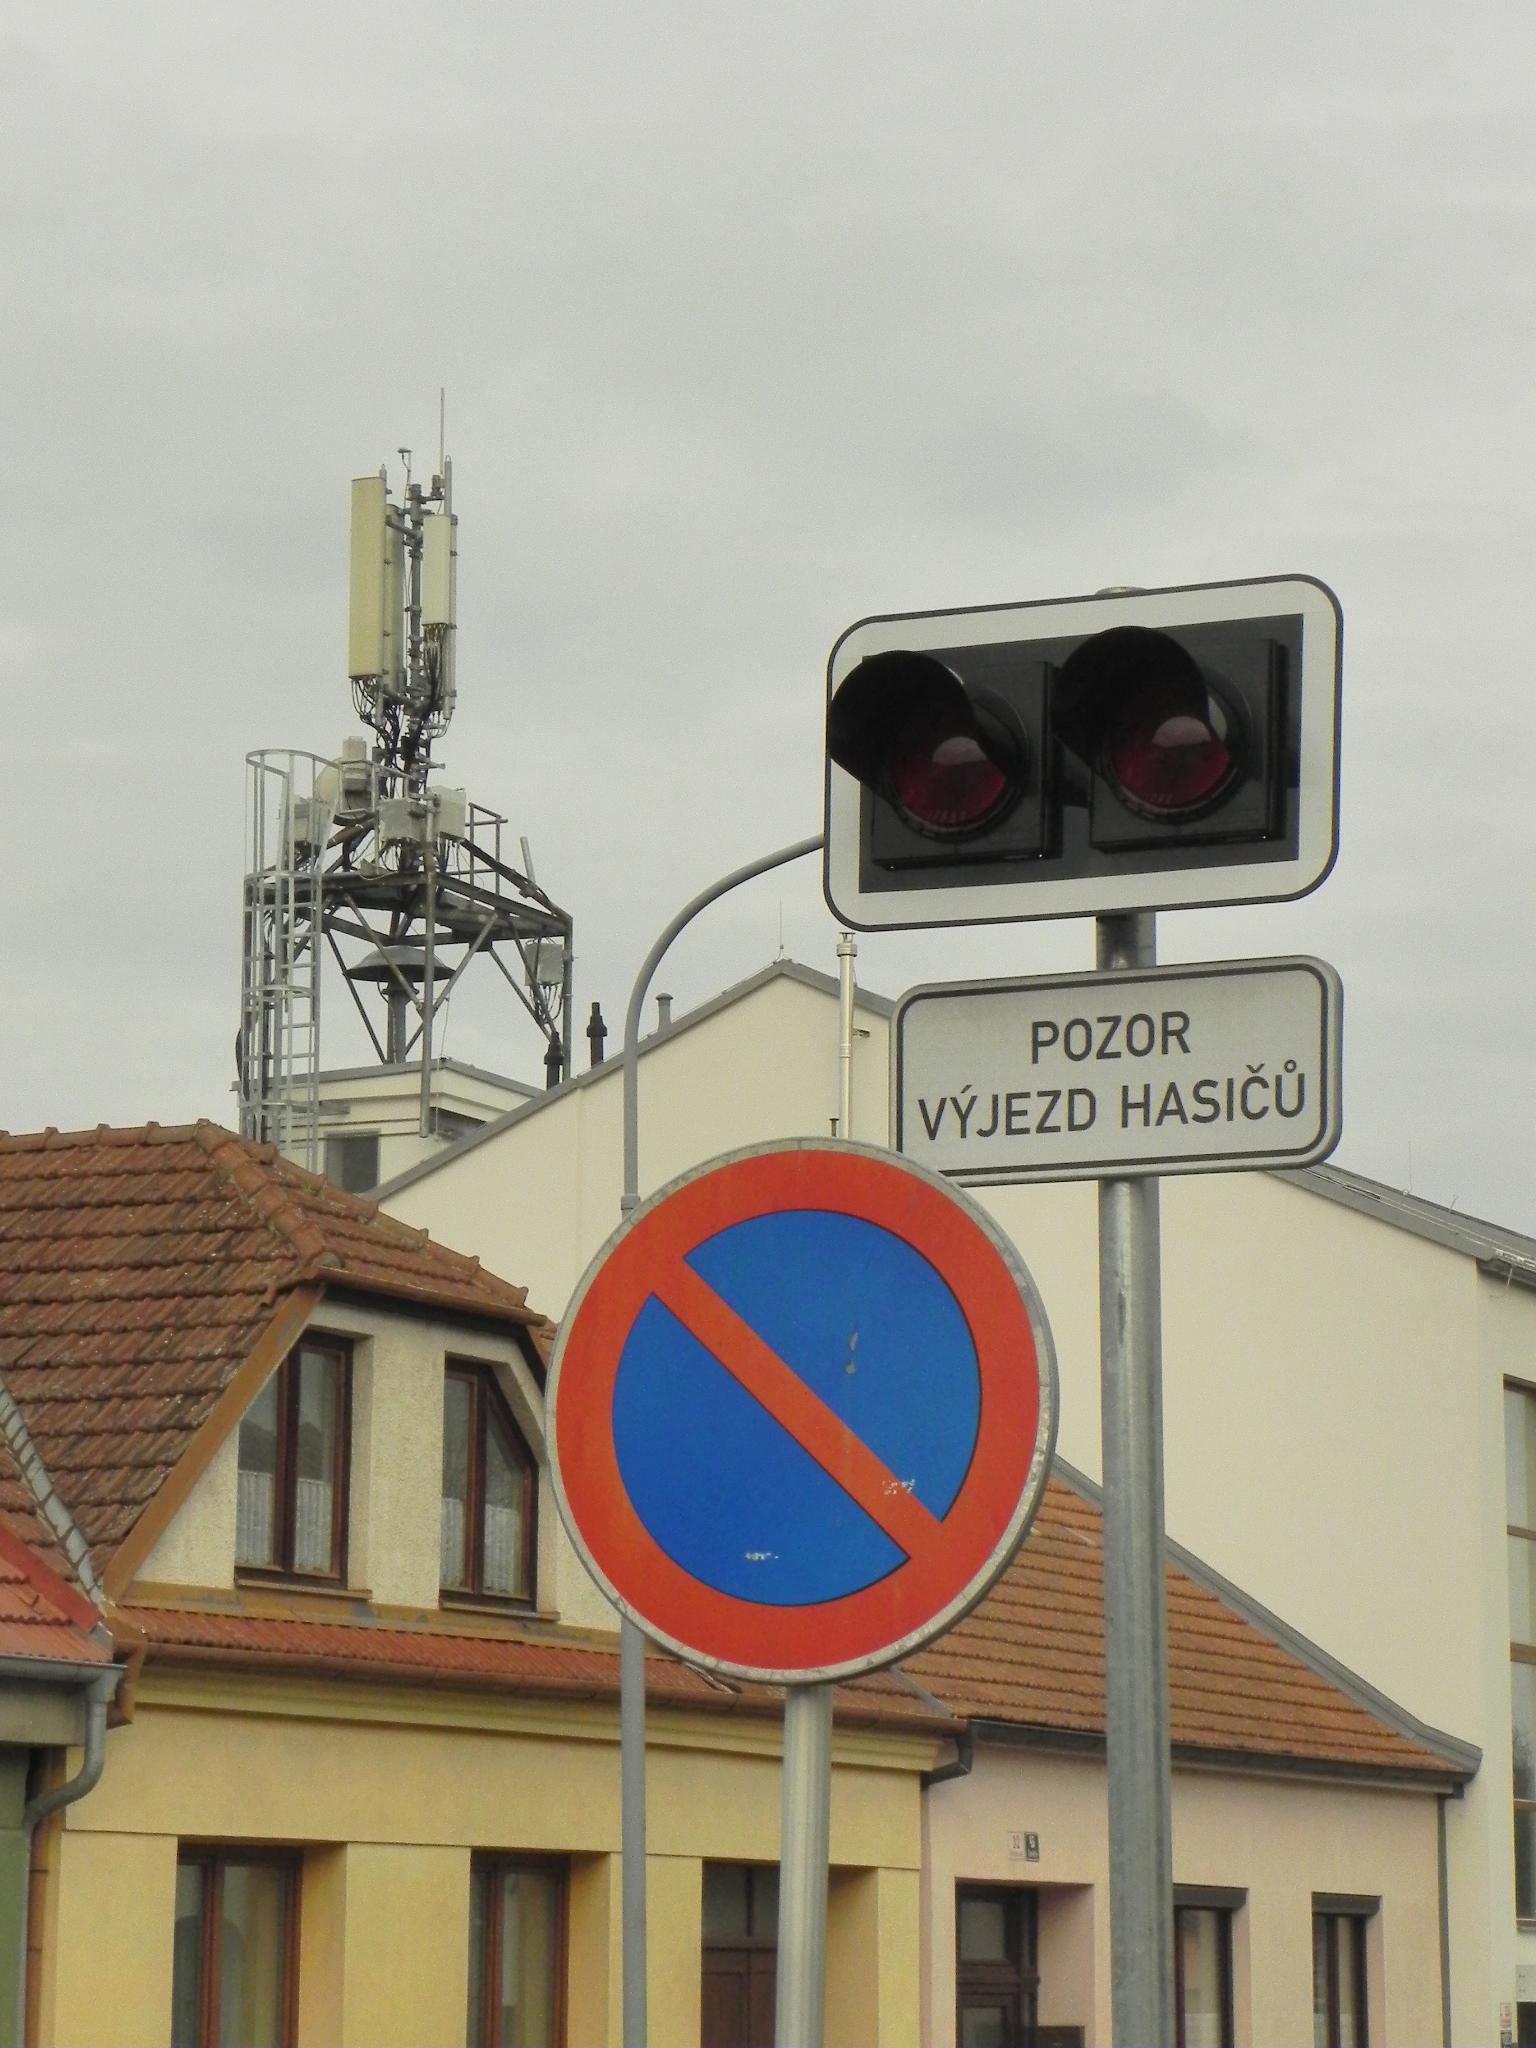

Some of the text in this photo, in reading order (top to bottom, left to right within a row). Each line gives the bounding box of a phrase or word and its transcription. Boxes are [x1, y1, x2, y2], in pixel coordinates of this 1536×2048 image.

[1031, 1011, 1191, 1065] POZOR
[918, 1059, 1305, 1141] VÝJEZD HASIČŮ
